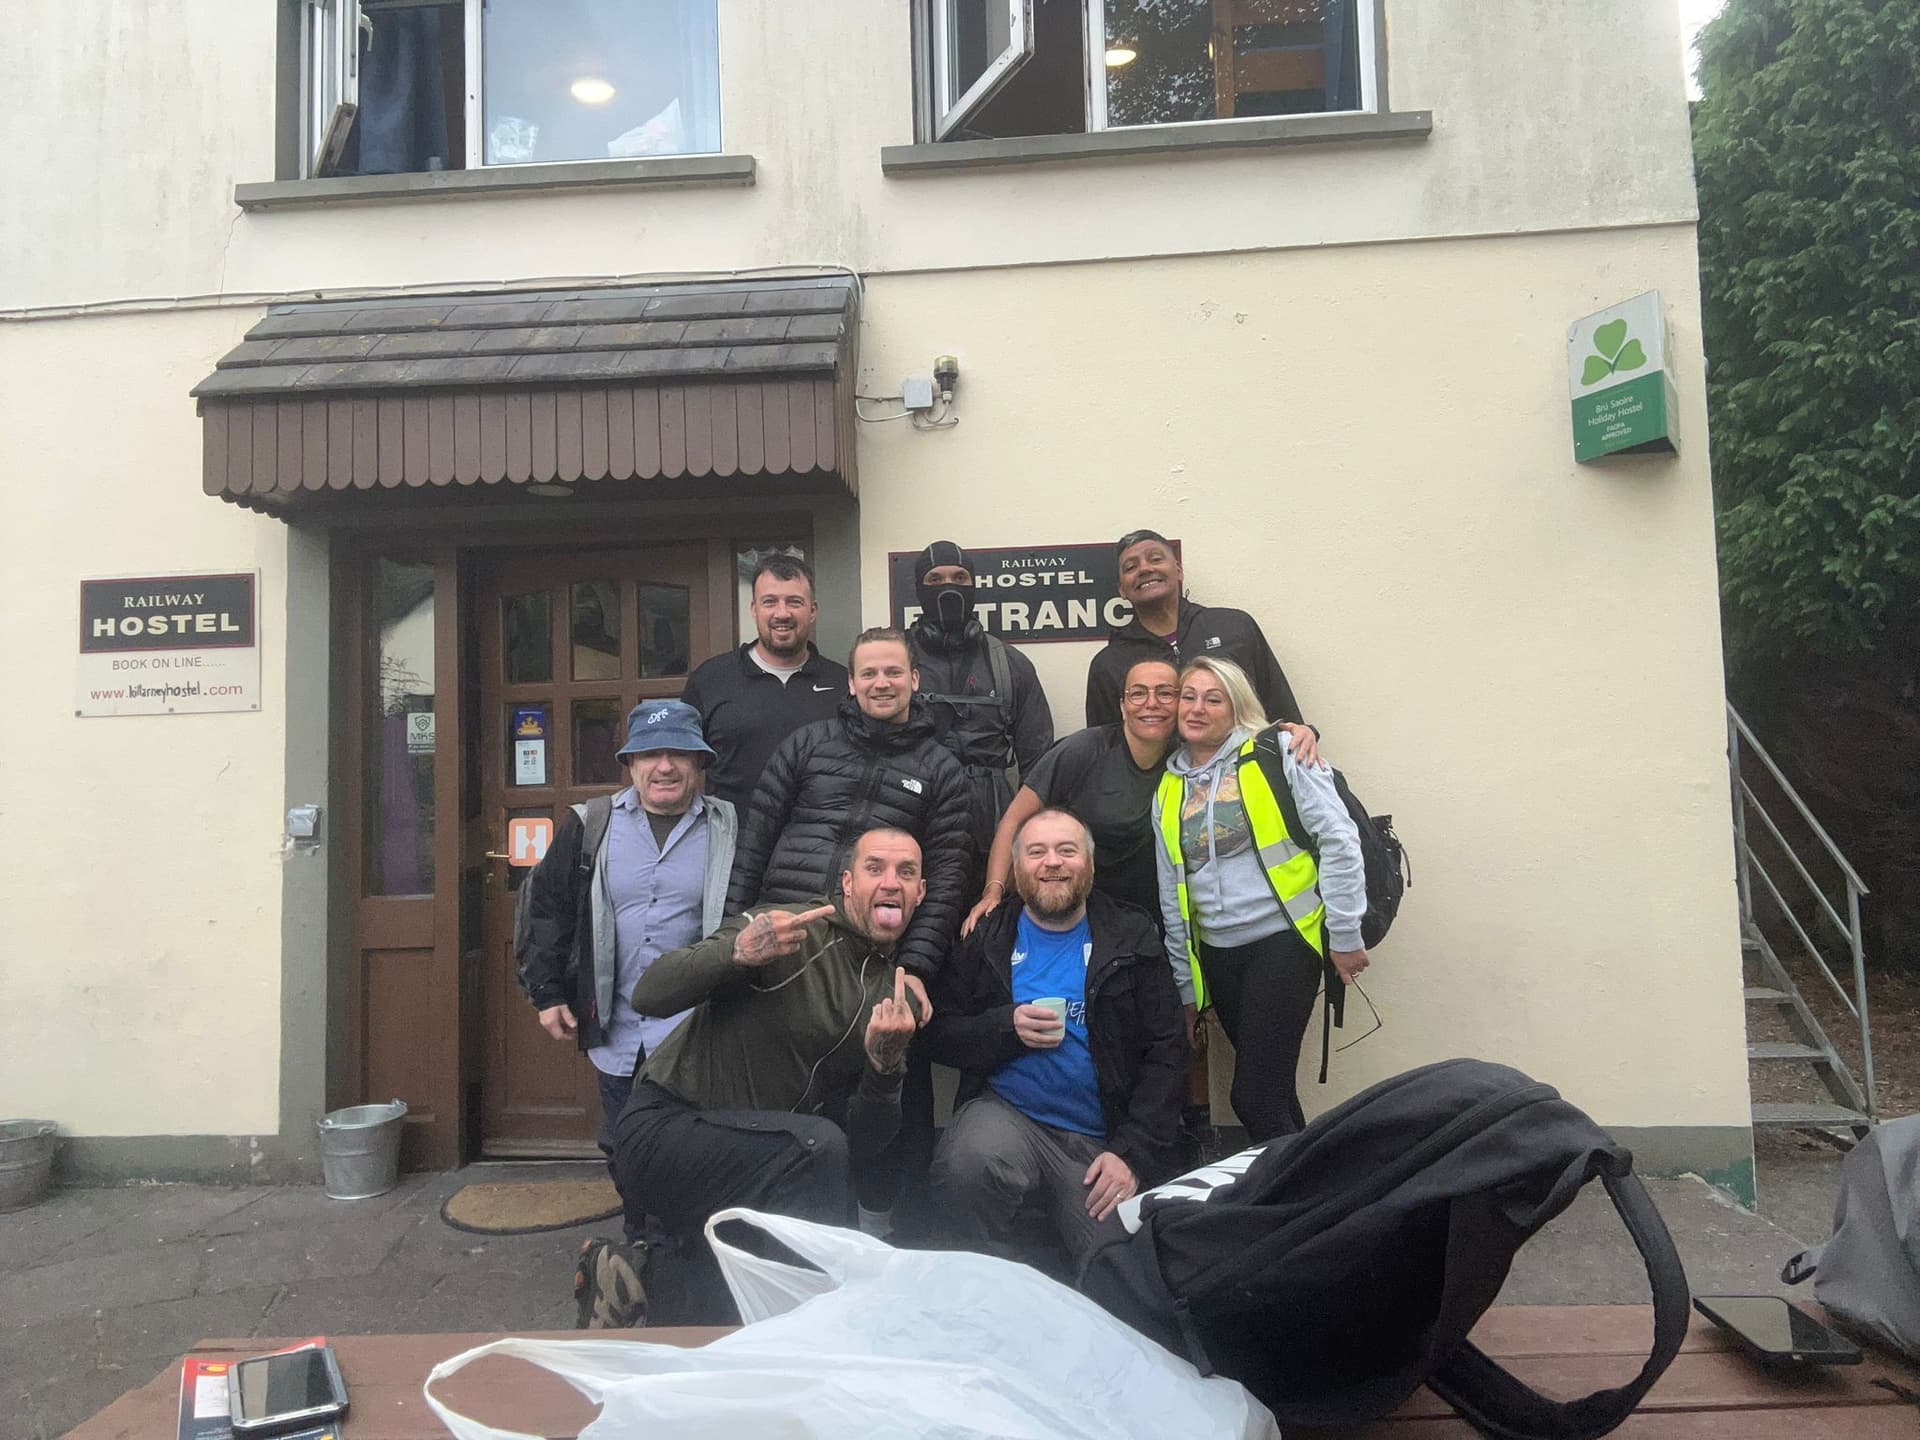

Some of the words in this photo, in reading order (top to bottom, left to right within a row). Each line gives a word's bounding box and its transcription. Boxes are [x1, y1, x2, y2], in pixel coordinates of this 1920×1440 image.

[1588, 413, 1616, 426] Holiday
[1617, 402, 1642, 416] Hostel
[1001, 557, 1067, 568] RAILWAY
[975, 571, 1094, 588] HOSTEL
[123, 593, 204, 608] RAILWAY
[904, 597, 1133, 631] ETRANC
[93, 613, 239, 637] HOSTEL
[112, 659, 147, 670] BOOK
[152, 658, 170, 669] ON
